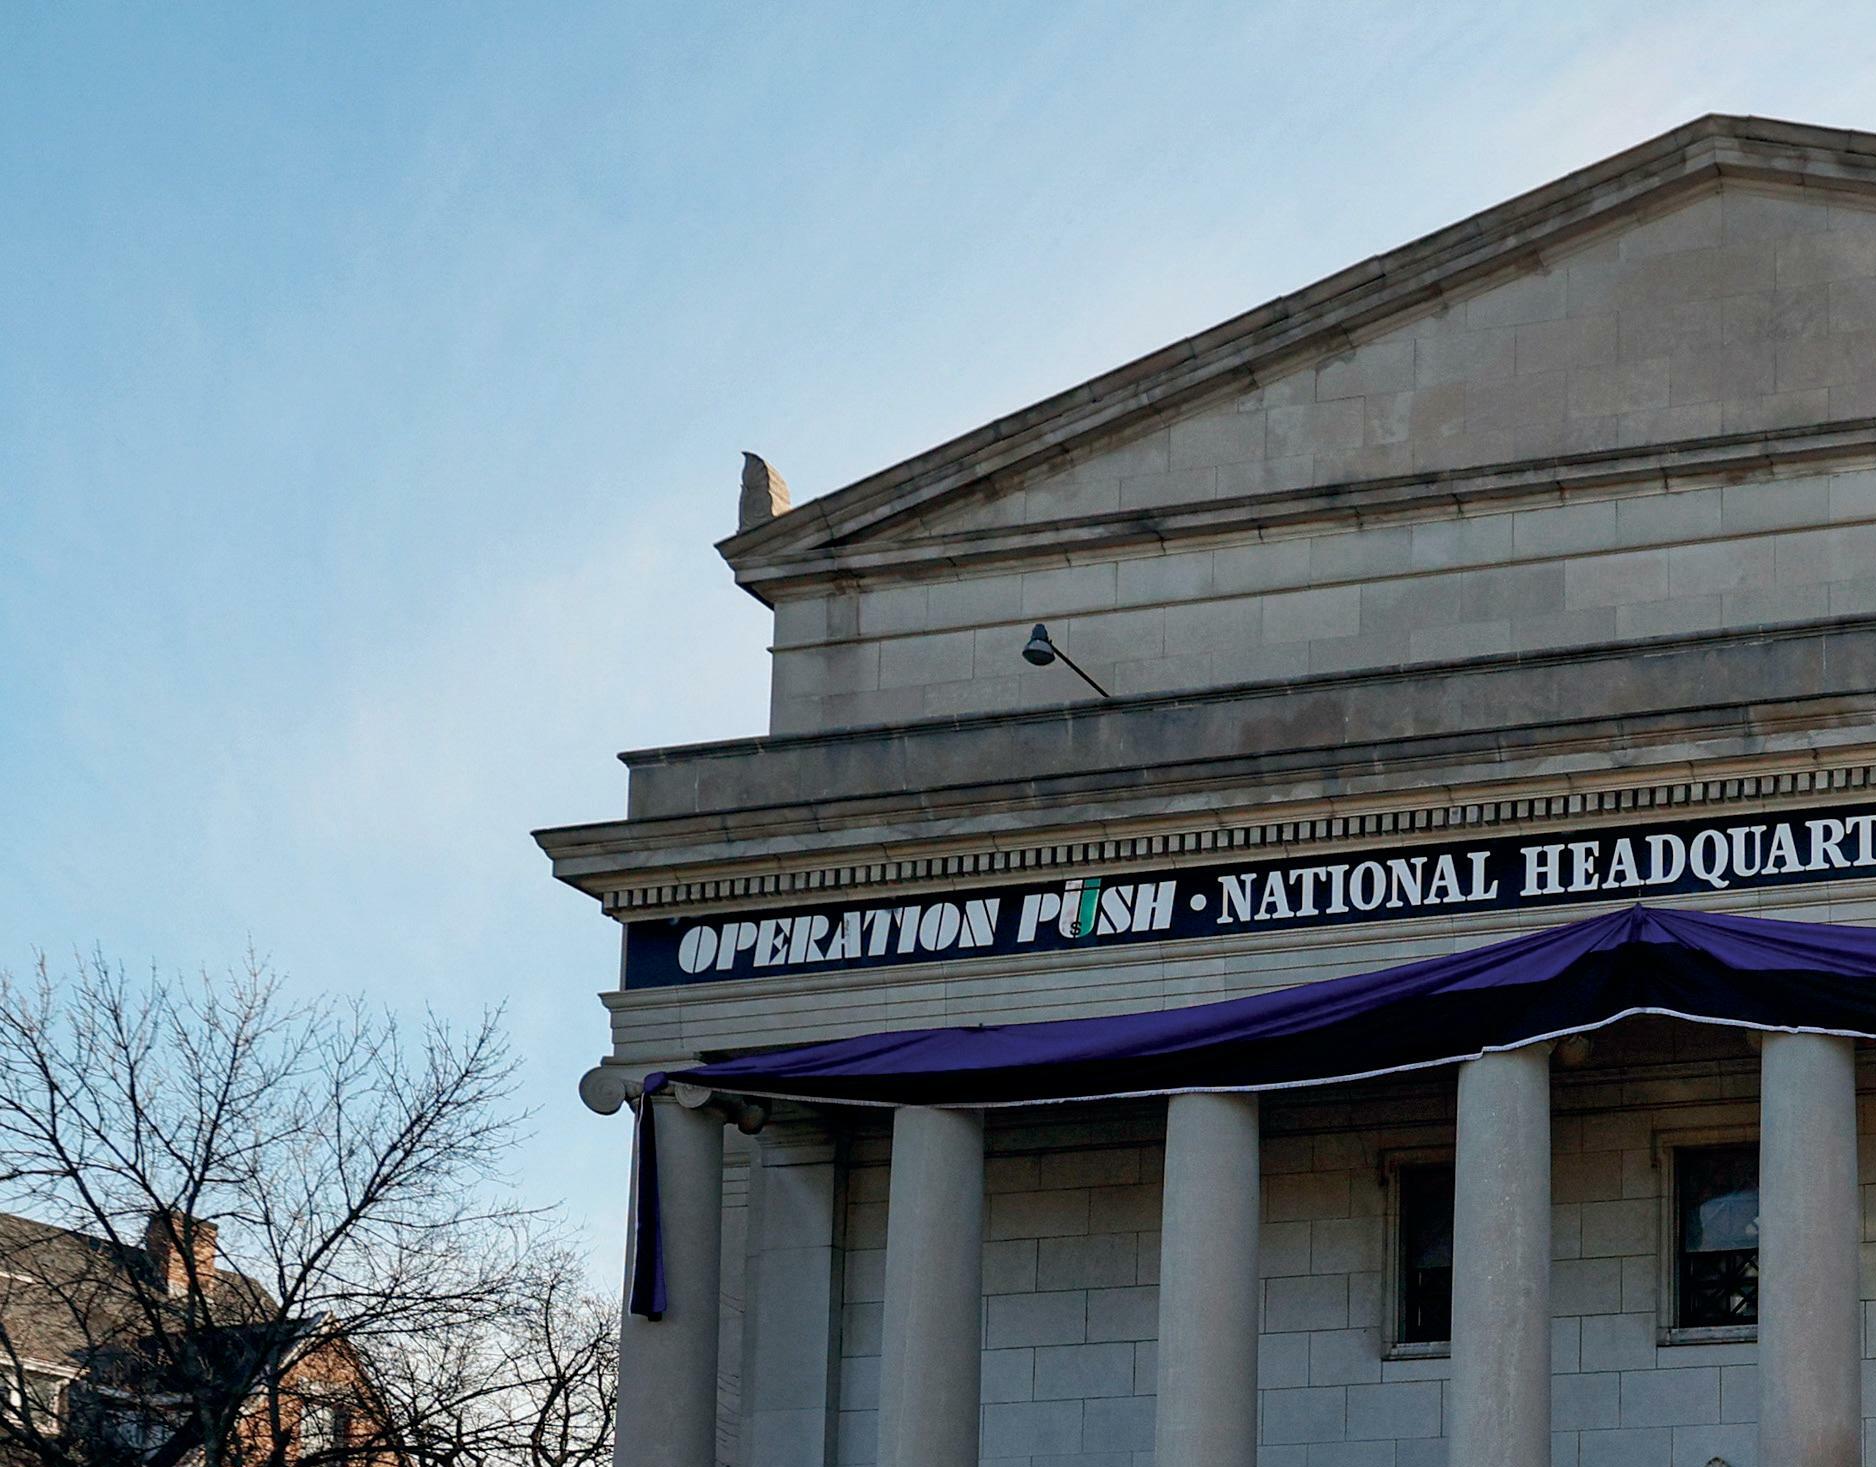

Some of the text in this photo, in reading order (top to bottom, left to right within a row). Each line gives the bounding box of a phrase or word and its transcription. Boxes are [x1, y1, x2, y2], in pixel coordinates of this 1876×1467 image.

[678, 900, 999, 974] OPERATION
[1016, 877, 1177, 942] PUSH
[1216, 850, 1499, 924] NATIONAL
